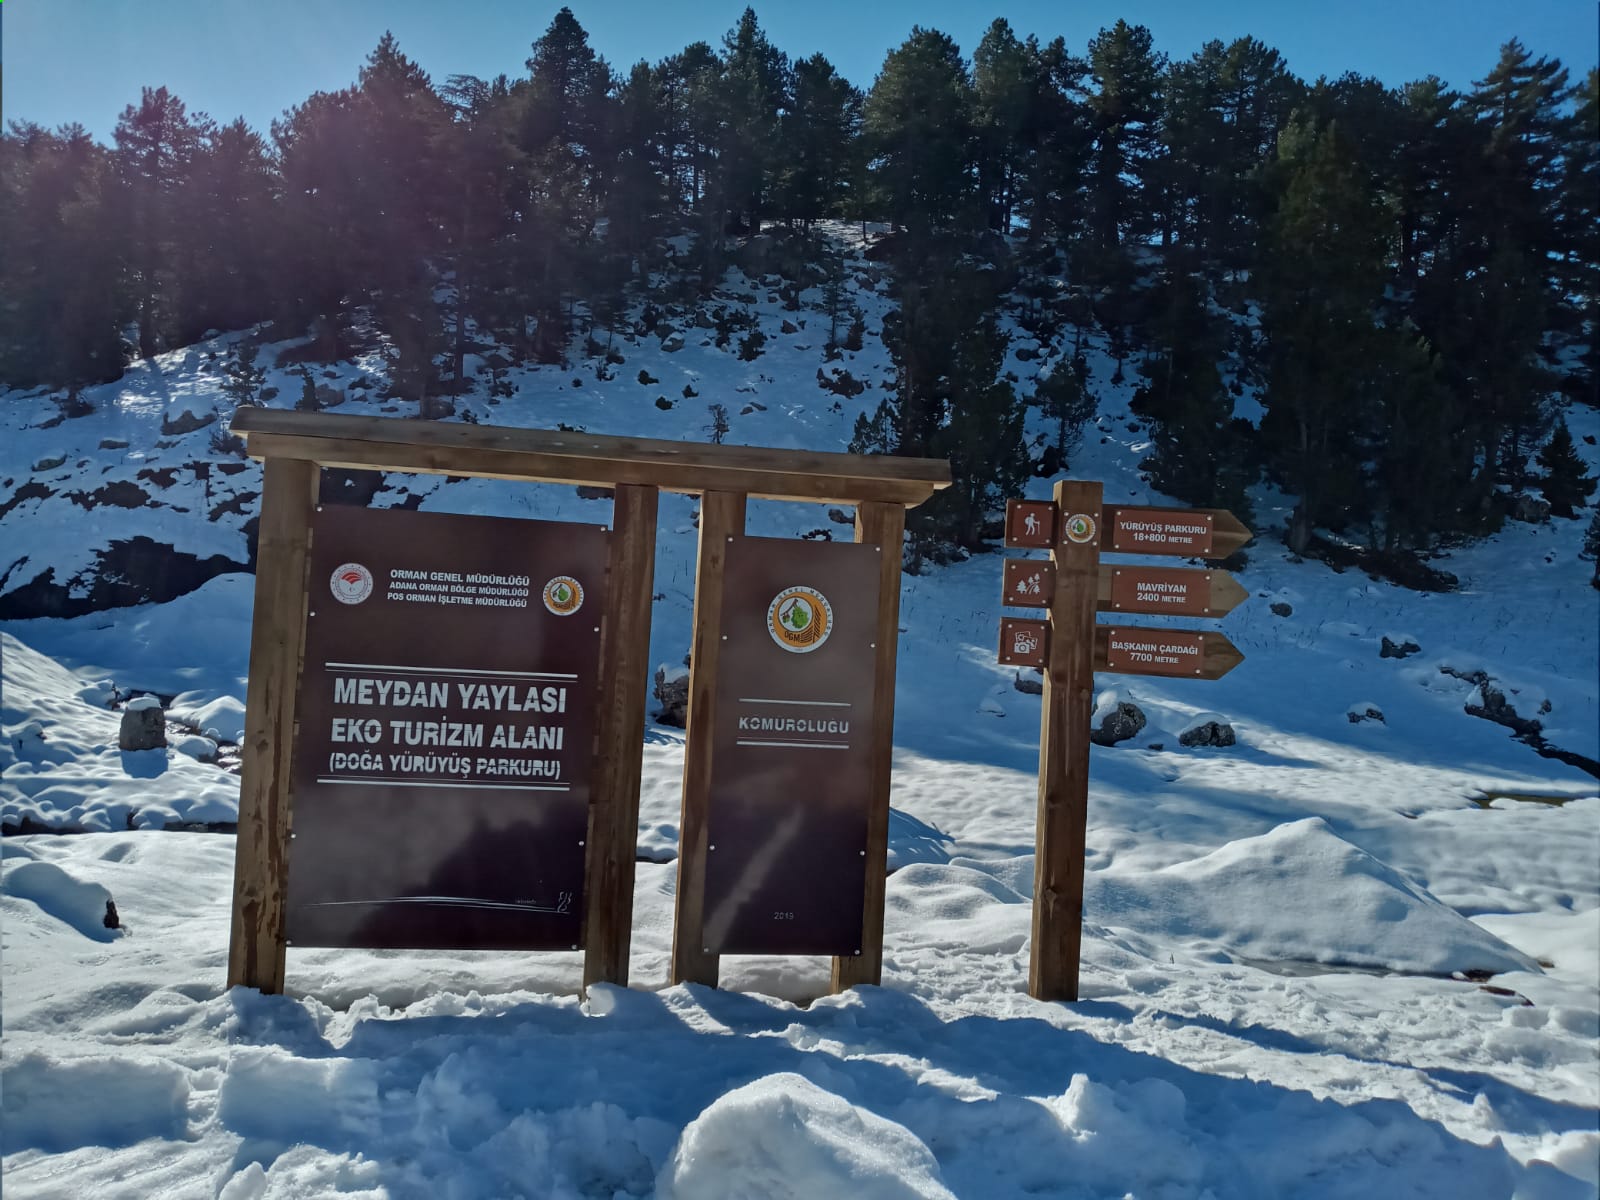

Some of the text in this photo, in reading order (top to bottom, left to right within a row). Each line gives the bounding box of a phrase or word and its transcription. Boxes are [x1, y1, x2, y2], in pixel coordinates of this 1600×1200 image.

[1165, 525, 1207, 535] PARKURU
[1133, 533, 1193, 544] 18+800 METRE
[390, 569, 530, 586] ORMAN GENEL MÜDÜRLÜĞÜ
[389, 581, 418, 590] ADANA
[419, 583, 449, 593] ORMAN
[450, 584, 477, 594] BÖLGE
[387, 592, 404, 601] POS
[406, 593, 436, 603] ORMAN
[438, 593, 473, 605] İŞLETME
[1137, 592, 1186, 603] 2400 METRE
[1111, 641, 1199, 656] BAŞKANIN ÇARDAĞI
[1130, 652, 1179, 664] 7700 METRE
[334, 677, 567, 713] MEYDAN YAYLASI
[331, 716, 564, 750] EKO TURİZM ALANI
[329, 749, 561, 780] (DOĞA YÜRÜYÜŞ PARKURU)
